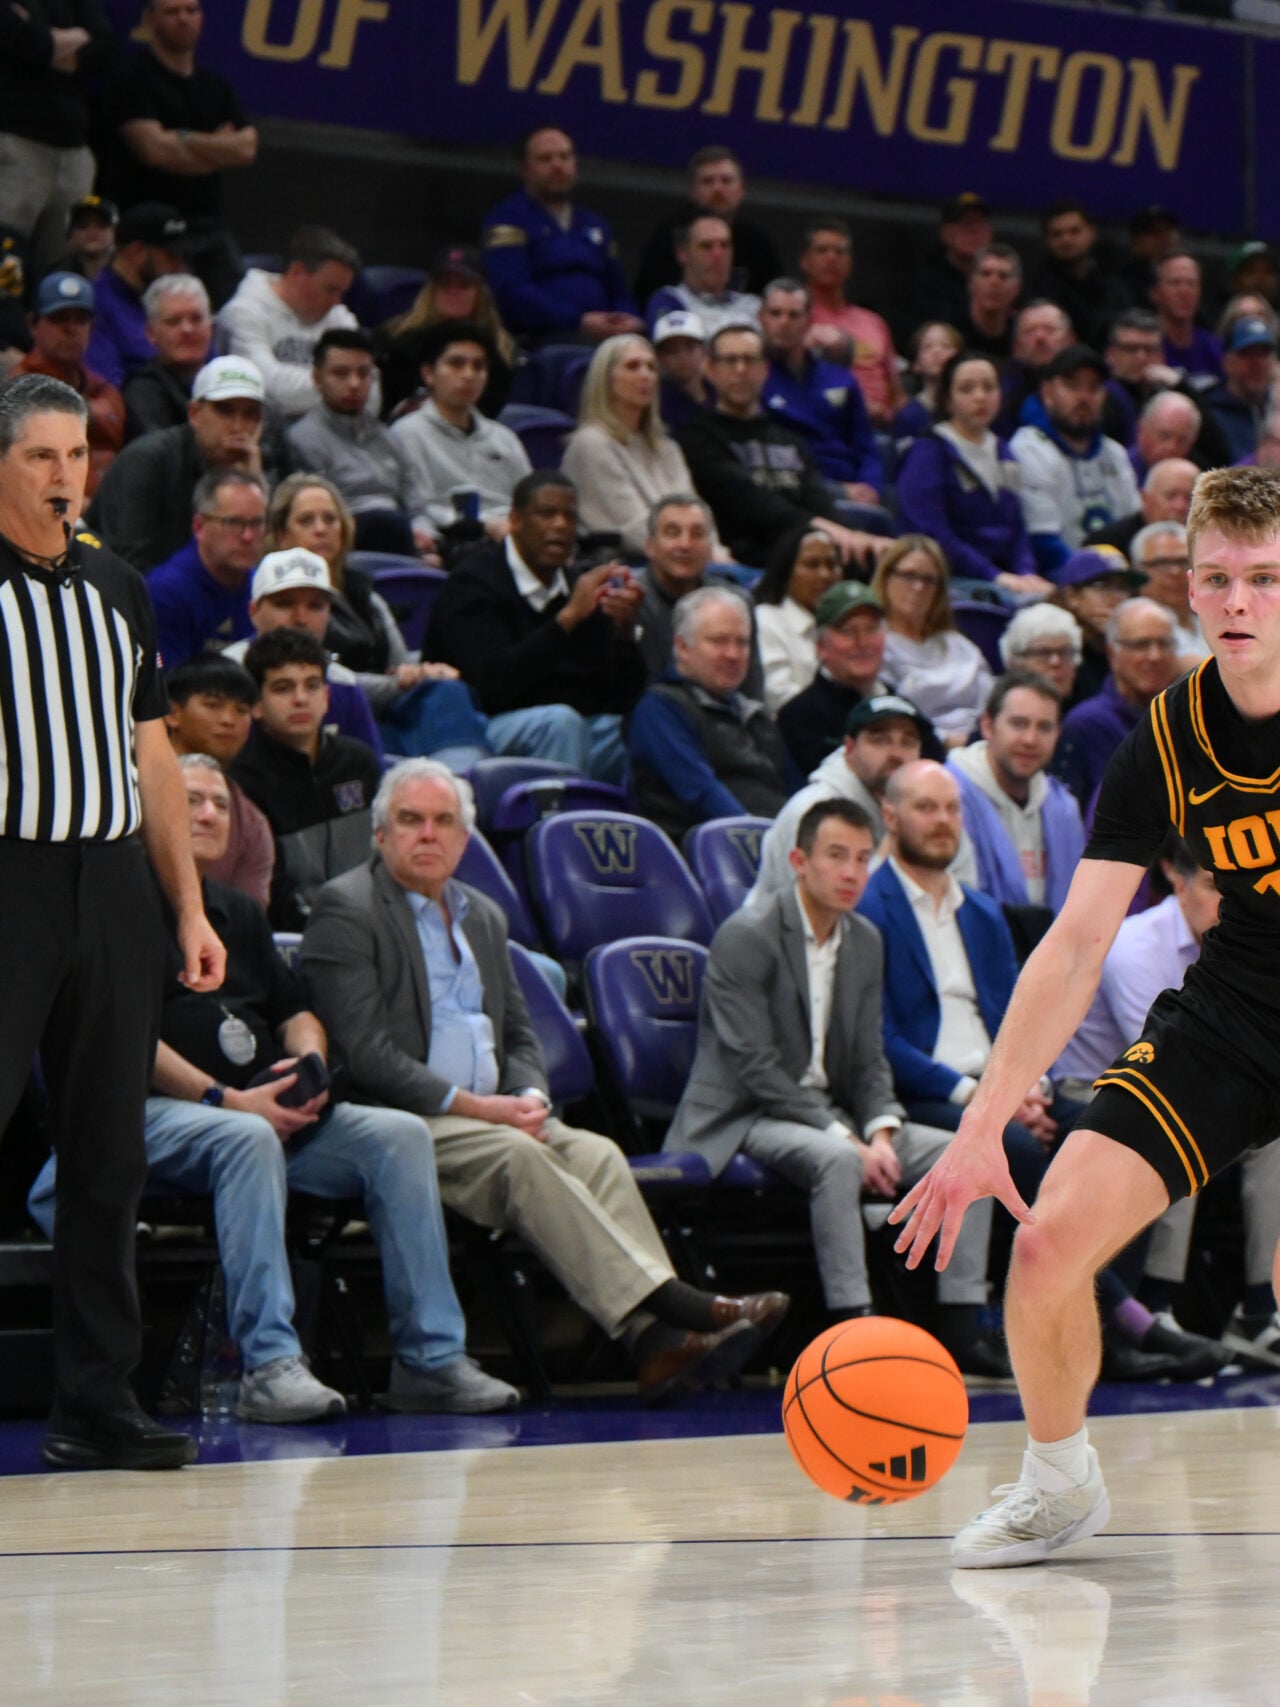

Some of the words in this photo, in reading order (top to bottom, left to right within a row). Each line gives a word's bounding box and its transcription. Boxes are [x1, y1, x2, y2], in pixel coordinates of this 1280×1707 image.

[241, 0, 389, 69] OF
[455, 0, 1200, 171] WASHINGTON
[573, 821, 638, 874] W
[630, 950, 694, 1005] W
